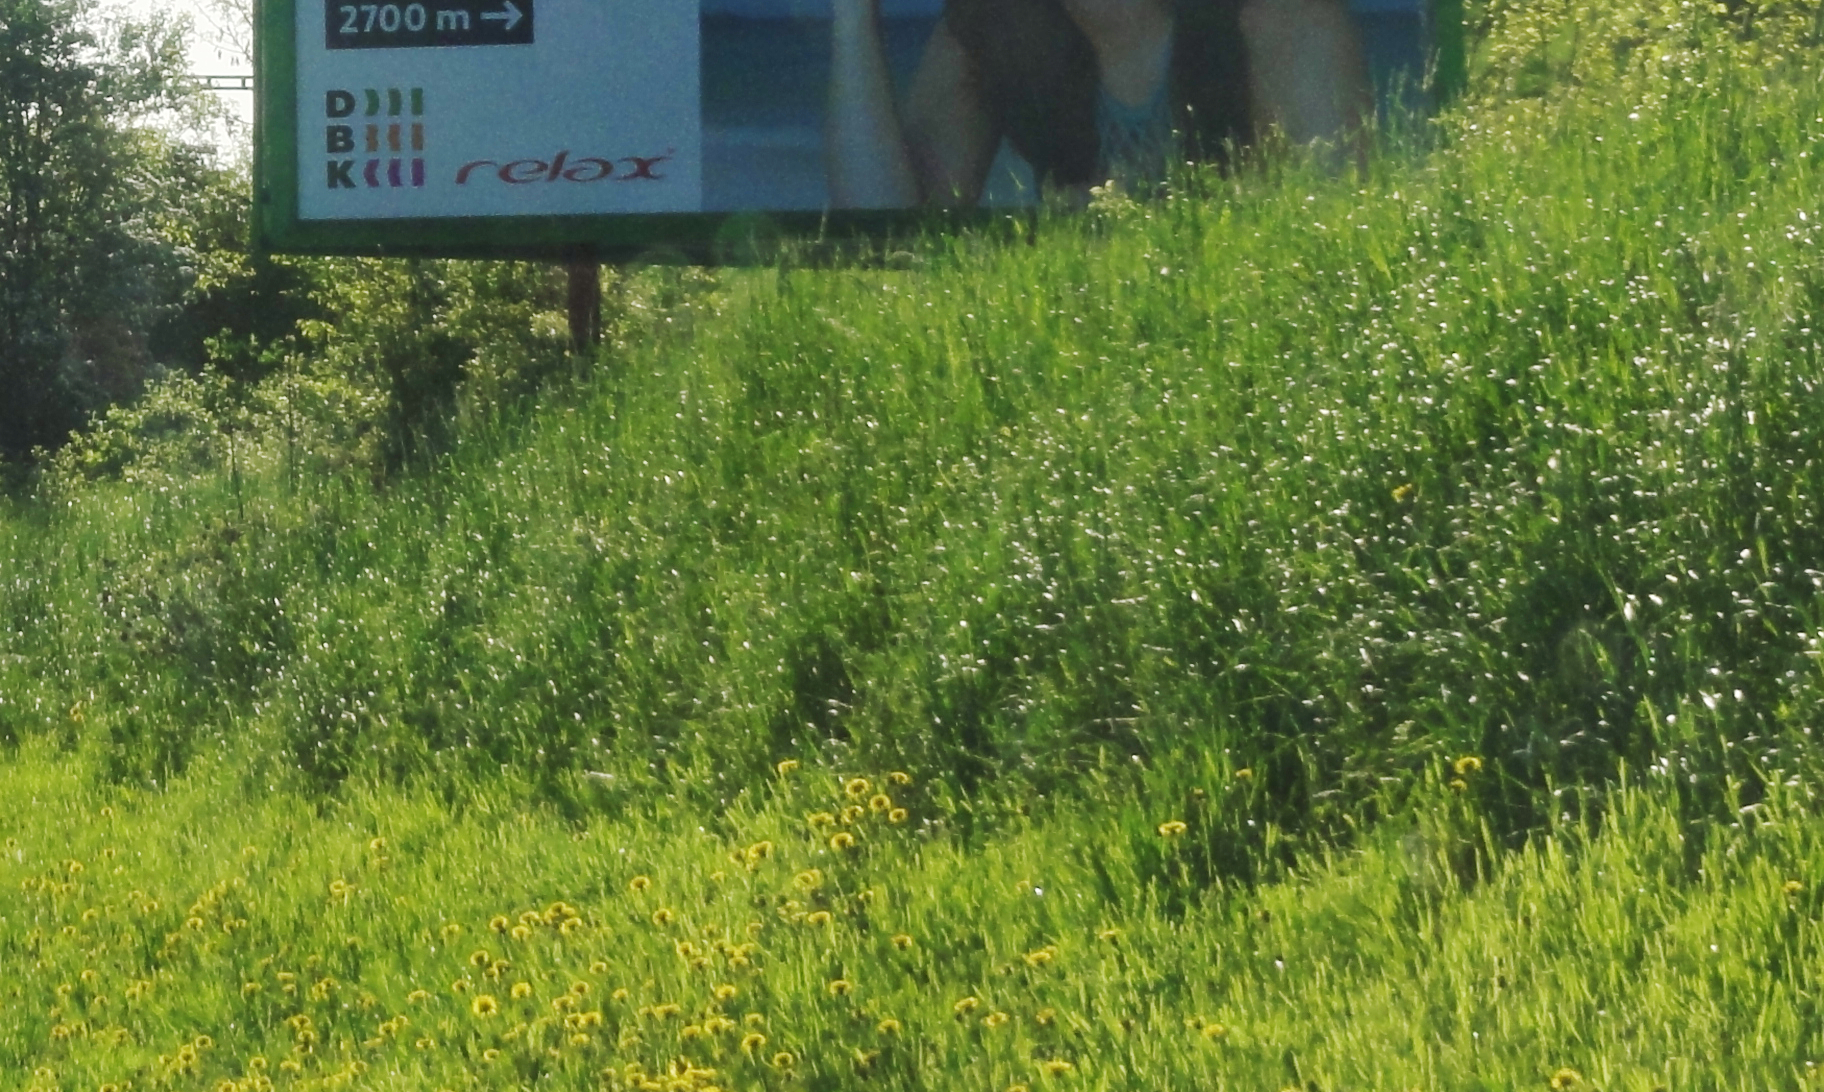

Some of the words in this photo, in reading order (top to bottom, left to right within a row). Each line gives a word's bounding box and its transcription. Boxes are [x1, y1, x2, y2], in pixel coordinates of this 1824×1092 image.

[339, 3, 426, 33] 2700
[436, 9, 469, 30] m
[455, 150, 669, 185] relax
